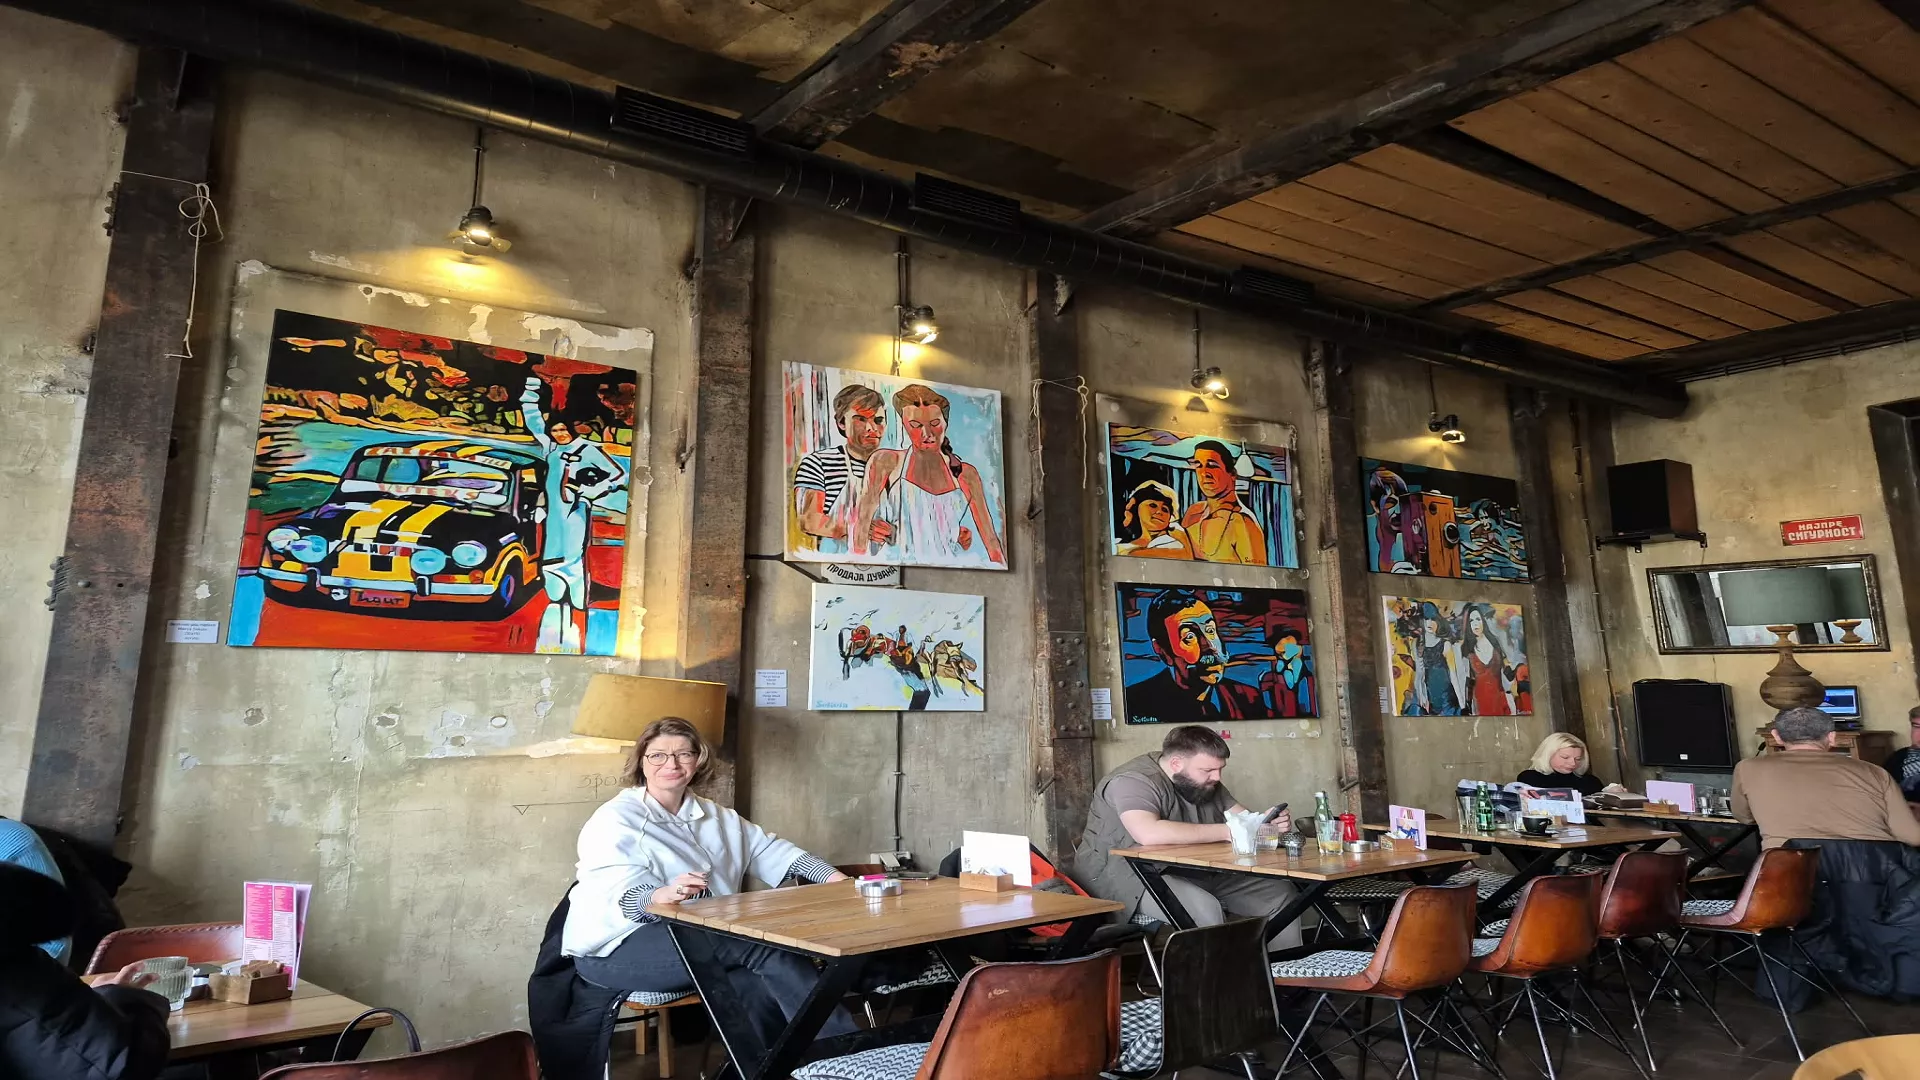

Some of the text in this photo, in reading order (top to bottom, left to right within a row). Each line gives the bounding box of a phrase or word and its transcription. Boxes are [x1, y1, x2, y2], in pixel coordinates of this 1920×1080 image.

[1788, 527, 1856, 541] СИГУРНОСТ
[1798, 521, 1843, 531] НАЈПРЕ
[827, 563, 898, 582] ПРОДАЈА ДУВАНА
[577, 773, 618, 799] зро
